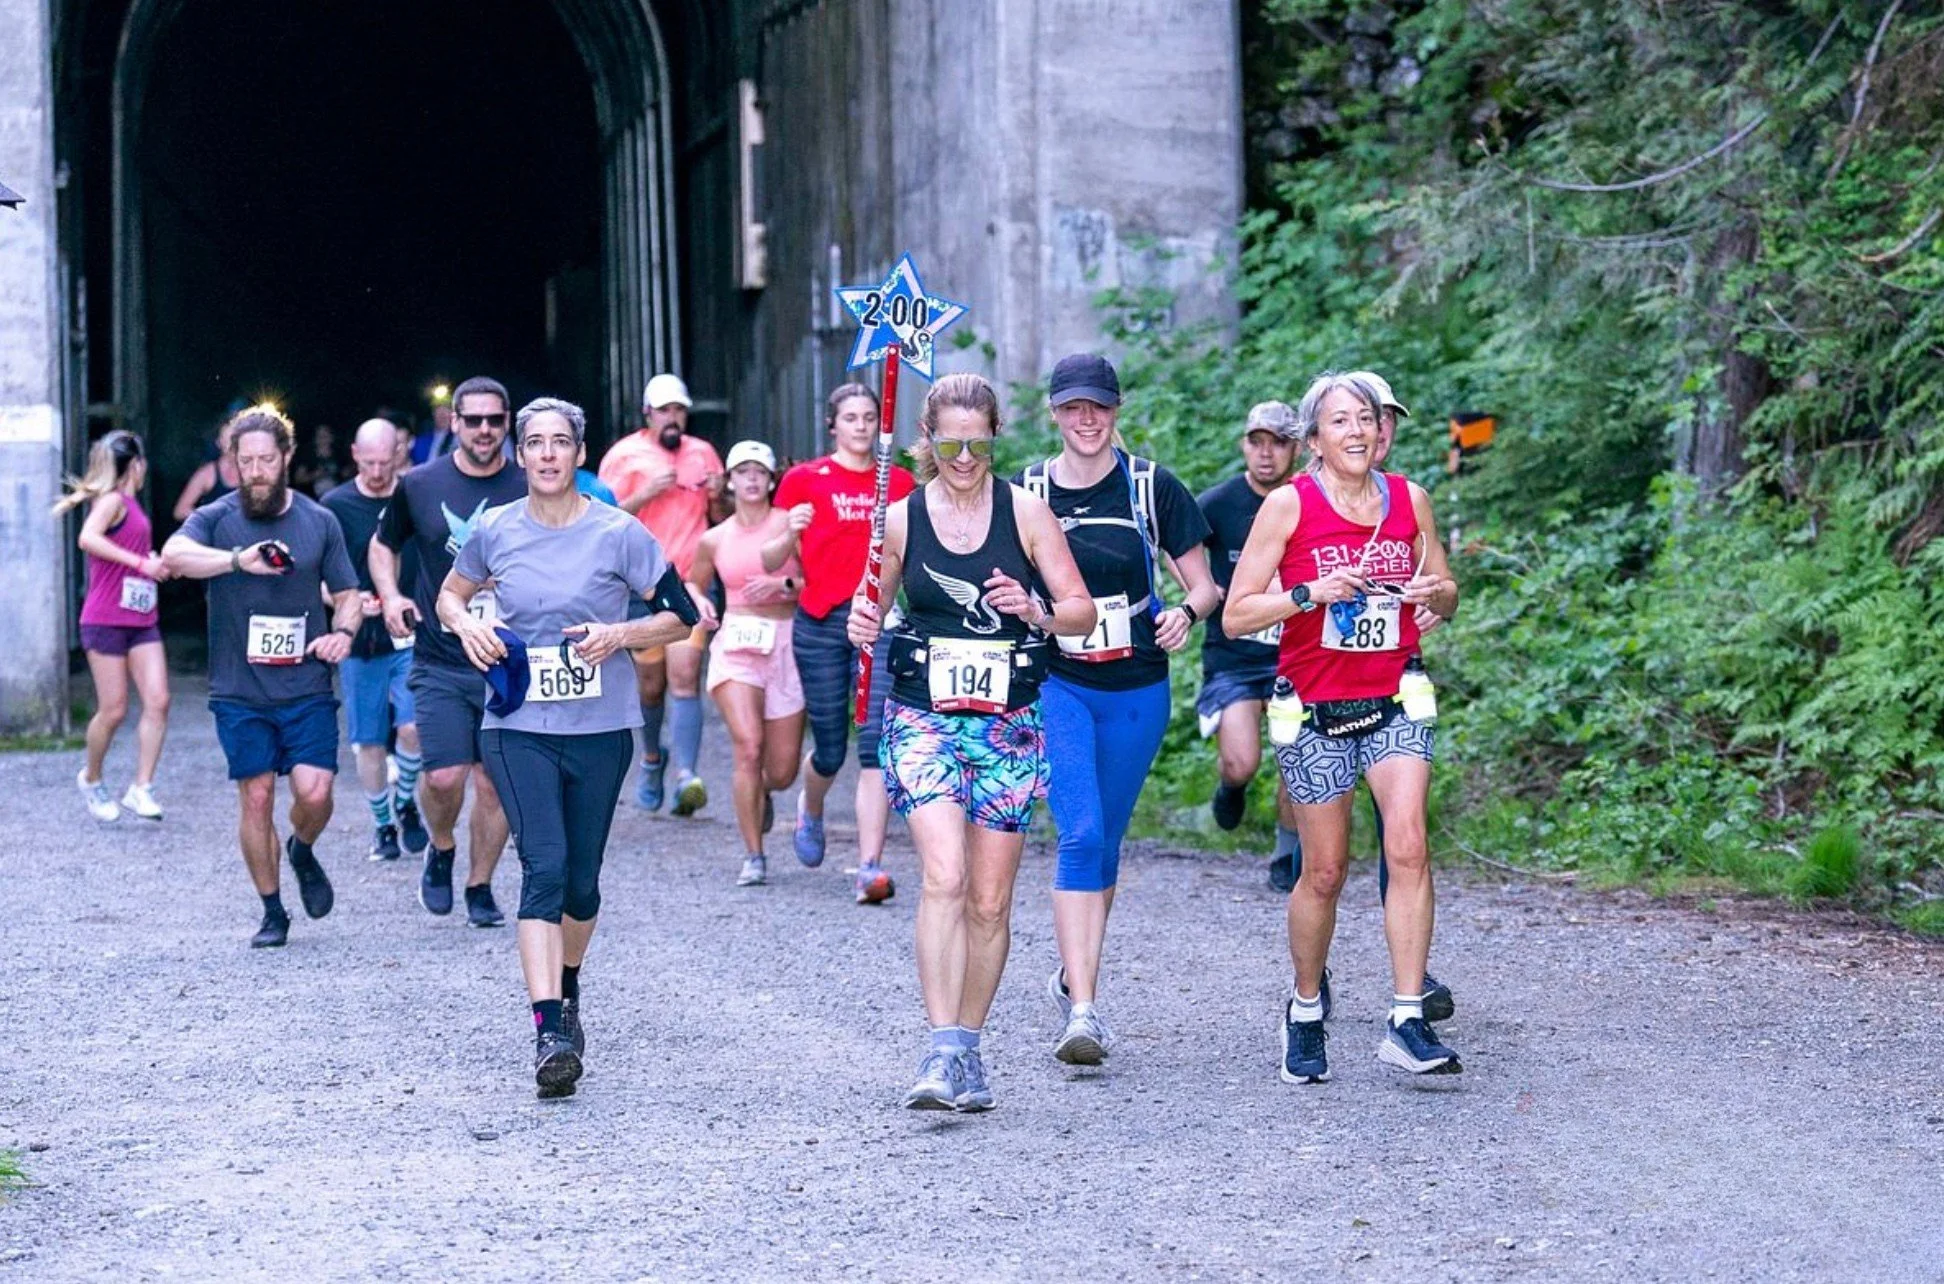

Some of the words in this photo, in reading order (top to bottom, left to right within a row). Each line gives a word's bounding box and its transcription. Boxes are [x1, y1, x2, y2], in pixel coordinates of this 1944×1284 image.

[261, 632, 295, 656] 525
[540, 666, 586, 698] 569
[948, 664, 992, 699] 194
[1326, 709, 1384, 737] NATHAN
